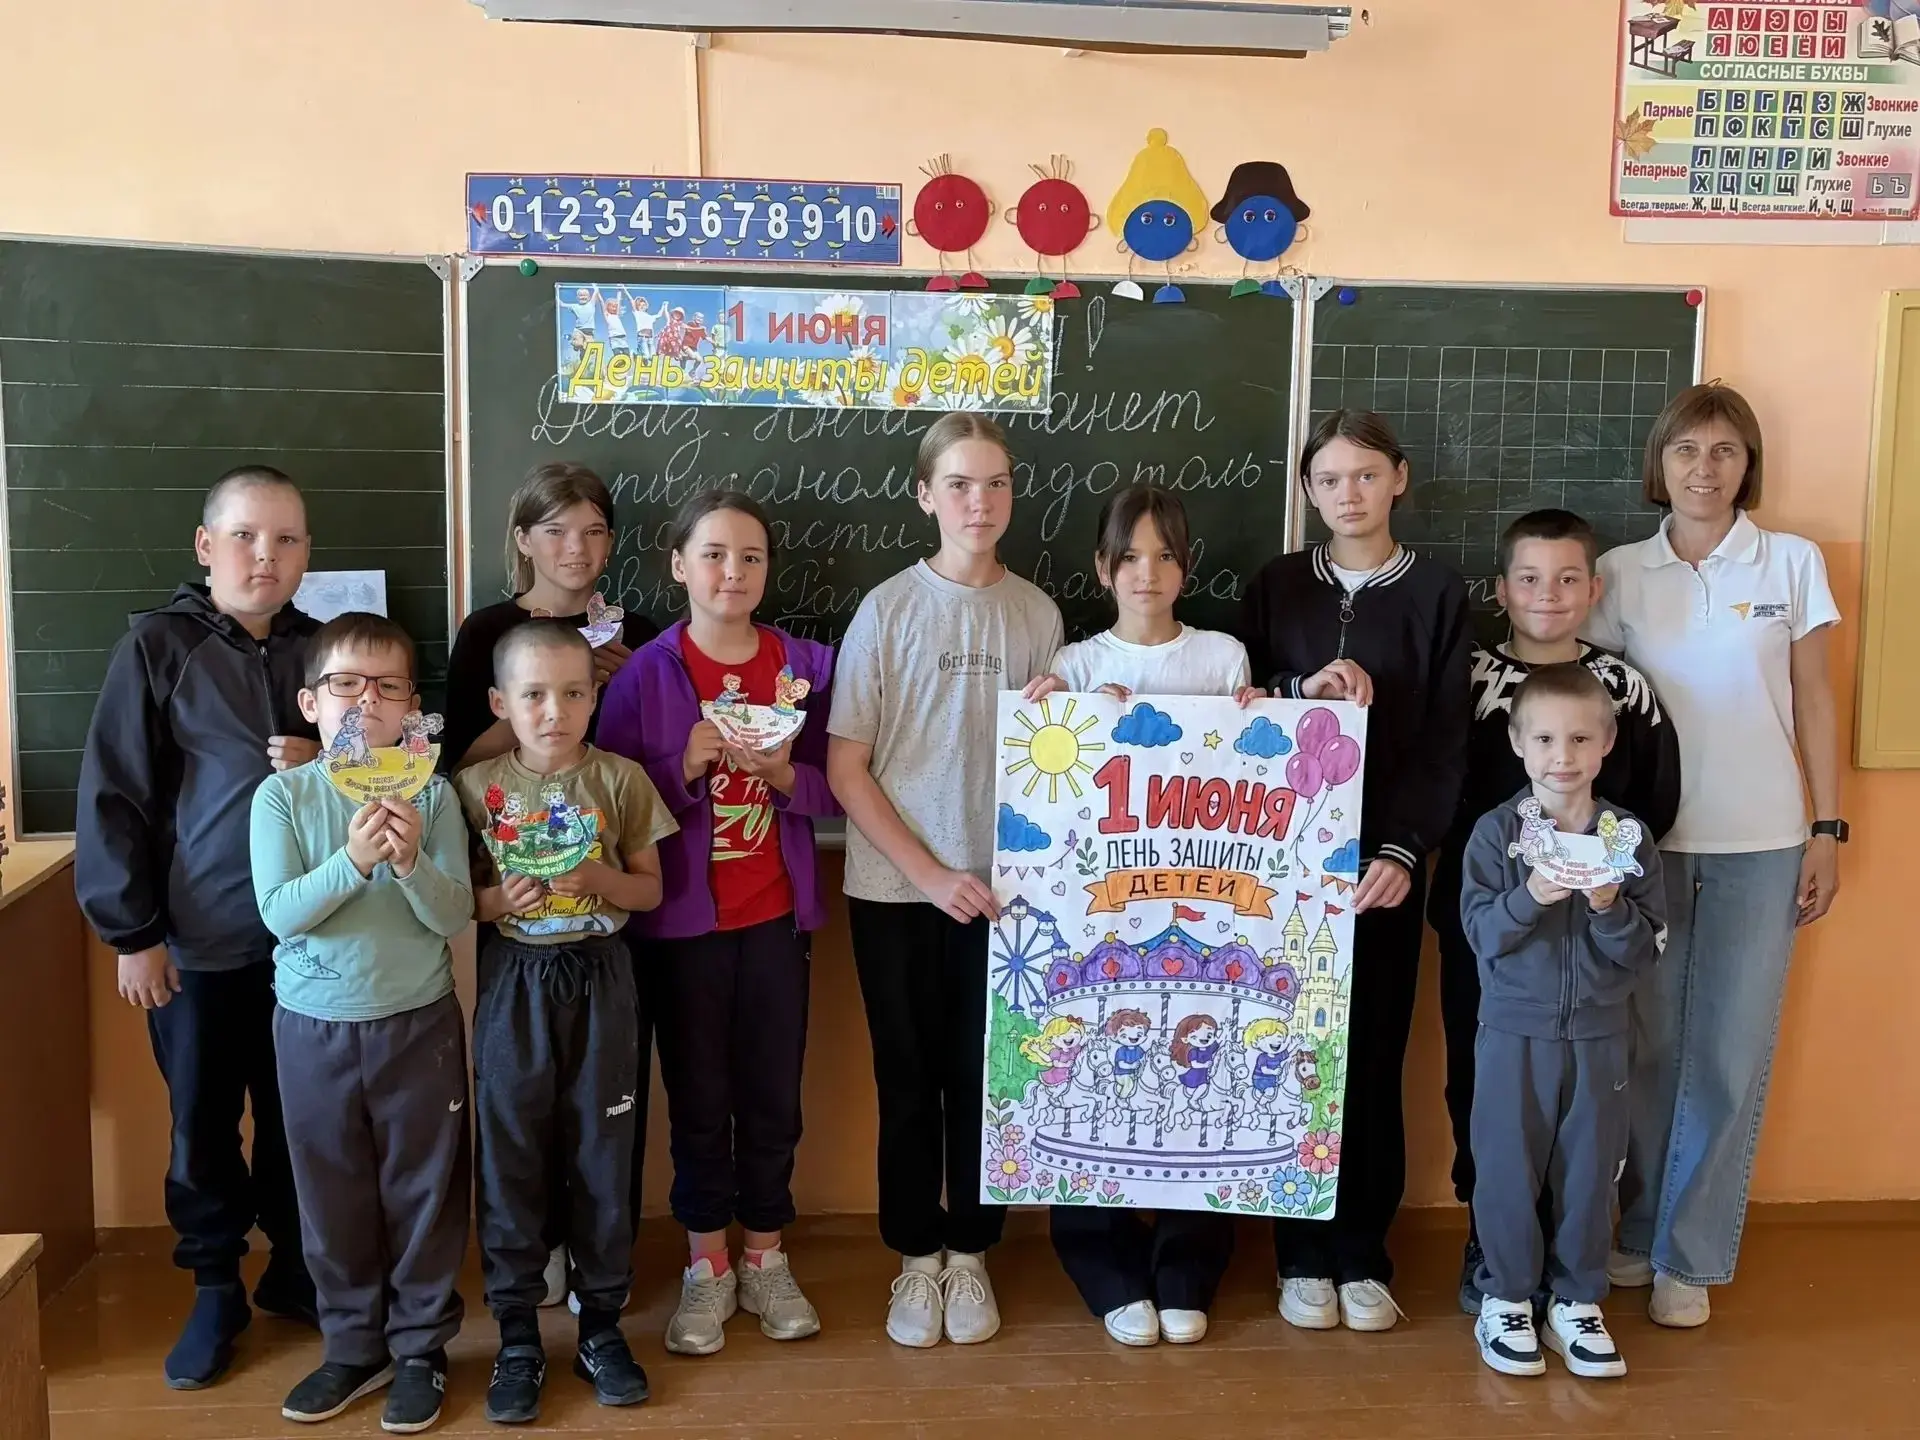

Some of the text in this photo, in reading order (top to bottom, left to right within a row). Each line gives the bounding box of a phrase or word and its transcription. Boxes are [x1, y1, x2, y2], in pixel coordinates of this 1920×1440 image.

[1711, 9, 1845, 32] А У Э О Ы
[1710, 34, 1841, 58] Я Ю Е Ё И
[1700, 63, 1868, 81] СОГЛАСНЫЕ БУКВЫ
[1643, 101, 1694, 120] Парные
[1702, 91, 1918, 114] Б В Г Д З Ж Звонкие
[1700, 115, 1912, 140] П Ф К Т С Ш Глухие
[1696, 147, 1889, 170] Л М Н Р Й Звонкие
[1623, 161, 1687, 180] Непарные
[509, 178, 840, 196] +1 +1 +1 +1 +1 +1 +1 +1 +1 +1
[1694, 173, 1851, 196] Х Ц Ч Щ Глухие
[1620, 199, 1649, 211] Всегда
[1651, 201, 1688, 211] твердые:
[1692, 197, 1707, 212] Ж,
[1711, 198, 1725, 212] Ш,
[1730, 198, 1739, 213] Ц
[1742, 202, 1771, 213] Всегда
[1773, 203, 1805, 213] мягкие:
[1841, 199, 1853, 215] Щ
[492, 195, 877, 243] 0 1 2 3 4 5 6 7 8 9 10
[513, 242, 840, 260] -1 -1 -1 -1 -1 -1 -1 -1 -1 -1
[728, 301, 886, 345] 1 июня
[568, 342, 1042, 399] День защиты детей
[938, 648, 1002, 676] Growing
[1093, 755, 1140, 834] 1
[1107, 838, 1263, 871] ДЕНЬ ЗАЩИТЫ
[1129, 873, 1237, 898] ДЕТЕЙ
